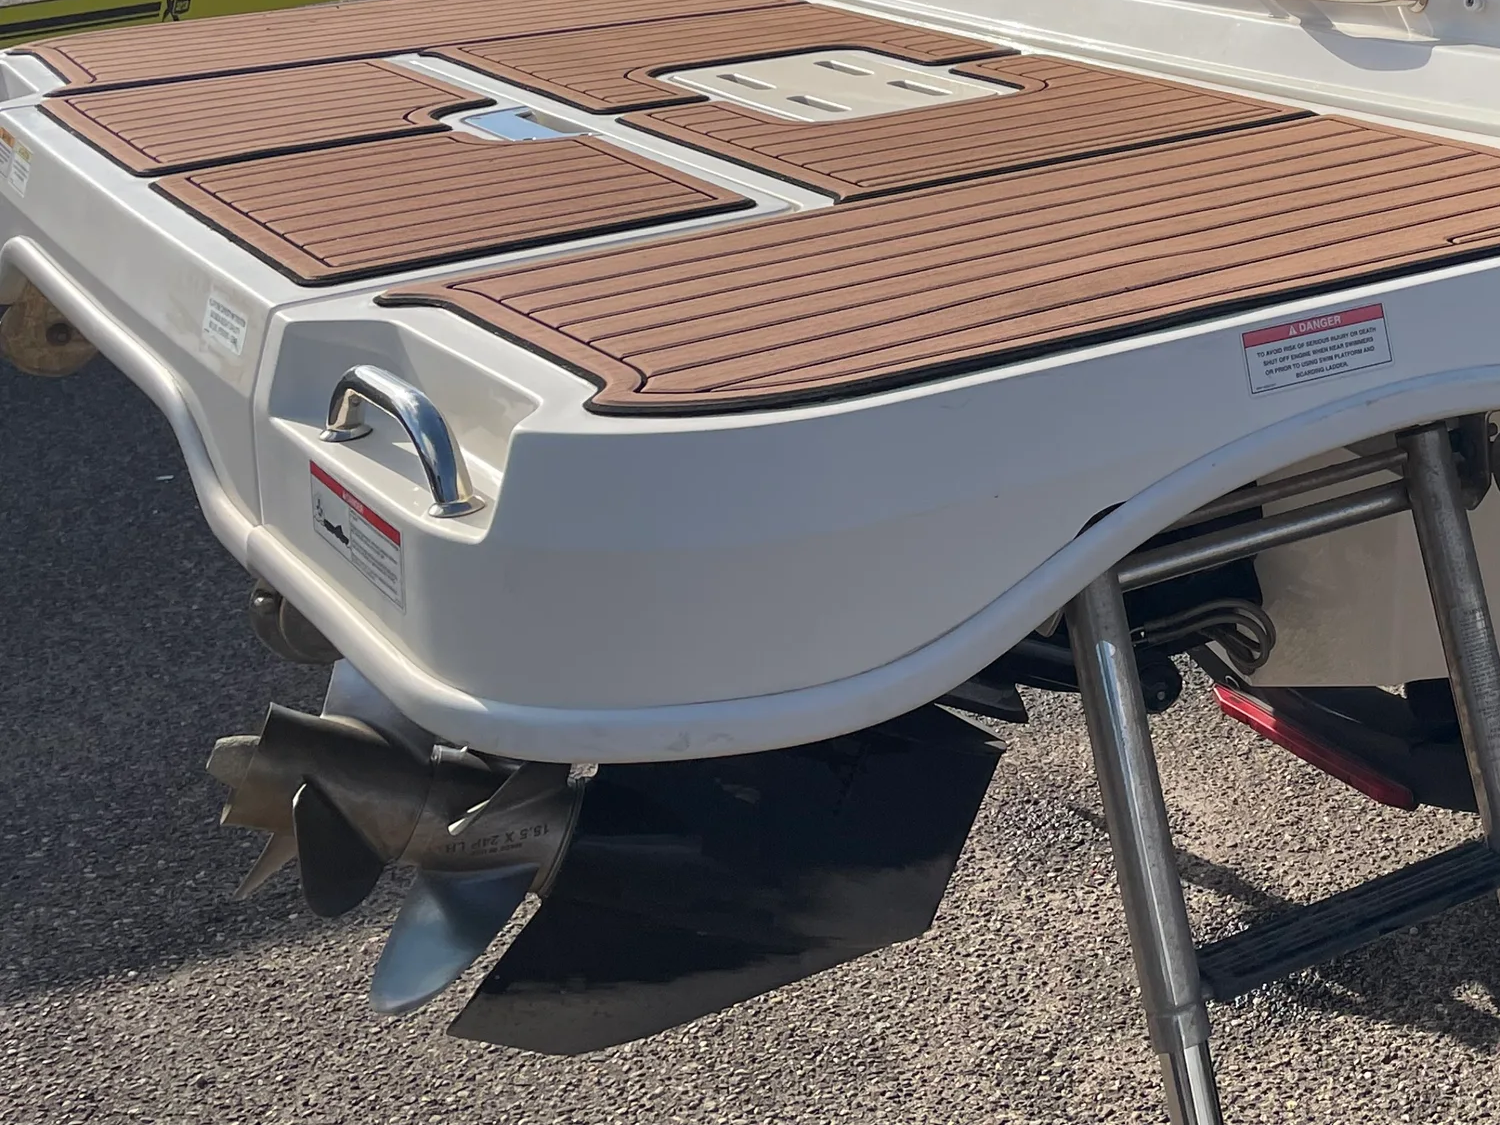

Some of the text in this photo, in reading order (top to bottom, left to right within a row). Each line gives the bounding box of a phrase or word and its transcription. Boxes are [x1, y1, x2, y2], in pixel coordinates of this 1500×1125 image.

[1298, 315, 1342, 332] DANGER
[1266, 348, 1282, 356] AVOID
[1306, 337, 1330, 348] SERIOUS
[1358, 327, 1376, 336] DEATH
[1262, 358, 1278, 366] SHUT
[1328, 343, 1344, 352] NEAR
[1274, 365, 1292, 374] PRIOR
[1300, 359, 1318, 368] USING
[1334, 349, 1362, 360] PLATFORM
